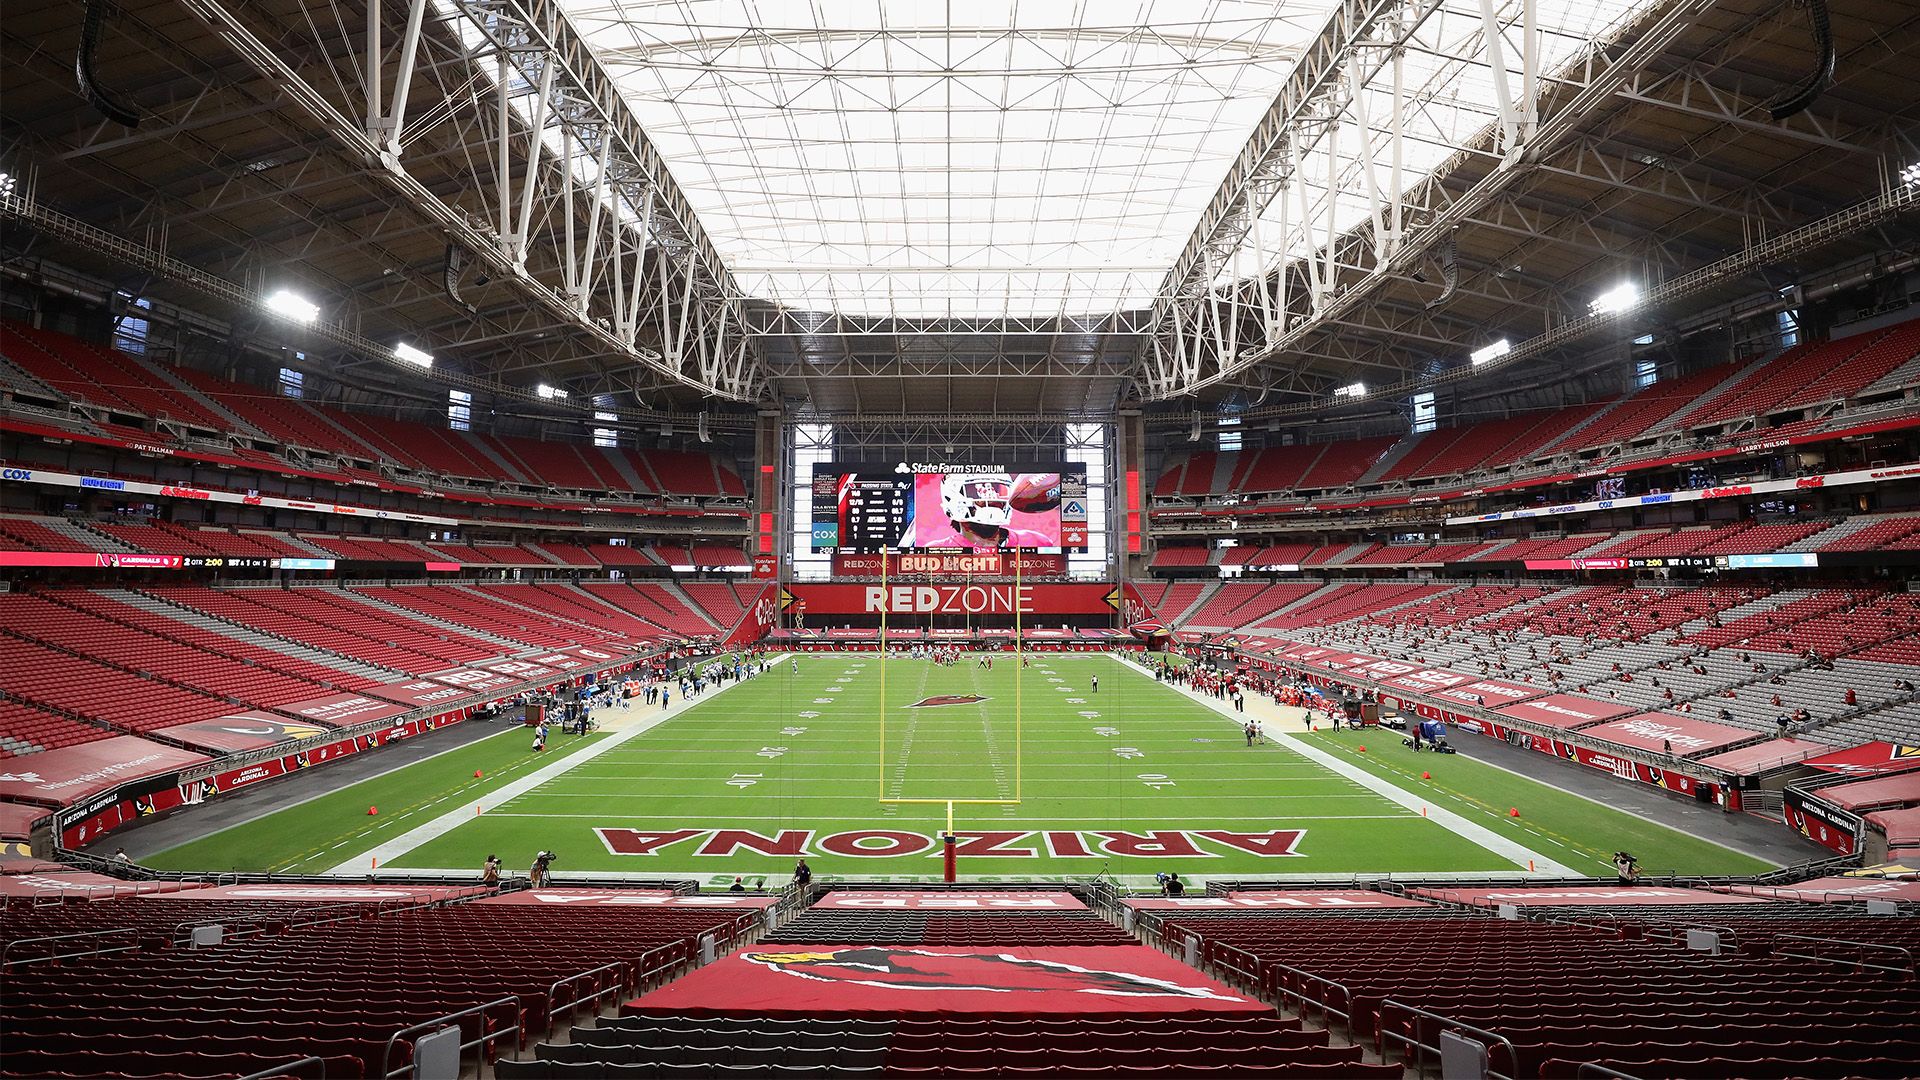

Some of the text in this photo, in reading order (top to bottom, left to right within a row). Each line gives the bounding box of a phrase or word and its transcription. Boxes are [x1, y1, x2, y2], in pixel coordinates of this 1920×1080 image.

[134, 443, 146, 451] PAT
[148, 445, 174, 455] TILLMAN
[1741, 443, 1762, 452] LARRY
[1763, 439, 1790, 449] WILSON
[965, 464, 1004, 473] STADIUM
[3, 469, 31, 481] COX
[814, 530, 836, 539] COX
[121, 557, 160, 565] CARDINALS
[173, 558, 179, 566] 7
[184, 558, 190, 566] 2
[246, 559, 250, 567] 1
[263, 559, 267, 567] 1
[901, 556, 997, 571] BUD LIGHT
[1687, 558, 1691, 566] 1
[1705, 558, 1710, 566] 1
[866, 586, 1035, 612] REDZONE
[489, 661, 541, 673] SEA
[1364, 661, 1415, 674] RED
[434, 670, 493, 685] RED
[1409, 670, 1465, 686] SEA
[402, 681, 438, 691] THE
[1391, 678, 1437, 690] FRONT
[1468, 682, 1530, 698] HONORS
[413, 688, 464, 701] THOSE
[301, 704, 328, 715] GILA
[1630, 719, 1682, 731] desert
[756, 747, 788, 757] 20
[1112, 747, 1145, 757] 20
[232, 769, 270, 785] CARDINALS
[240, 766, 263, 777] ARIZONA
[725, 773, 763, 786] 10
[1136, 774, 1176, 787] 10
[63, 793, 118, 827] ARIZONA CARDINALS
[1802, 801, 1826, 818] ARIZONA
[592, 828, 1308, 858] ARIZONA
[709, 875, 767, 885] US
[532, 896, 744, 904] SEA
[1168, 898, 1381, 906] THE
